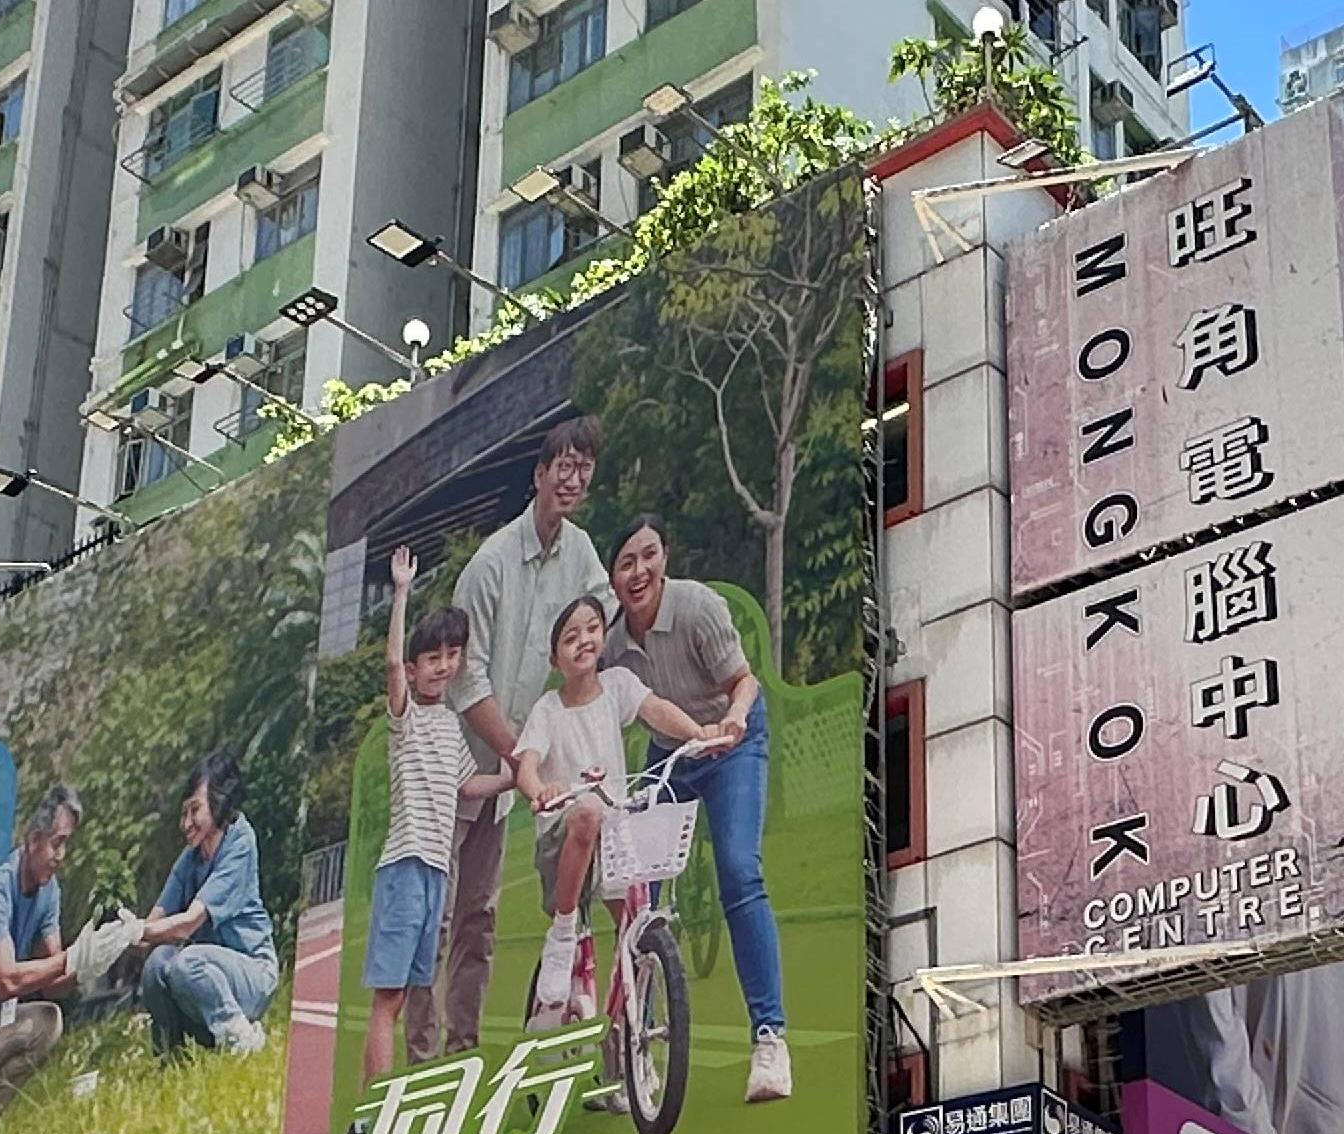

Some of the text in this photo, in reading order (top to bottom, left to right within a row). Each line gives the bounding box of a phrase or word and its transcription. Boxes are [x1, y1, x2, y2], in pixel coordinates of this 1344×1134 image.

[1073, 231, 1149, 879] MONG KOK
[1168, 176, 1291, 842] 旺角電腦中心
[1083, 847, 1300, 931] COMPUTER
